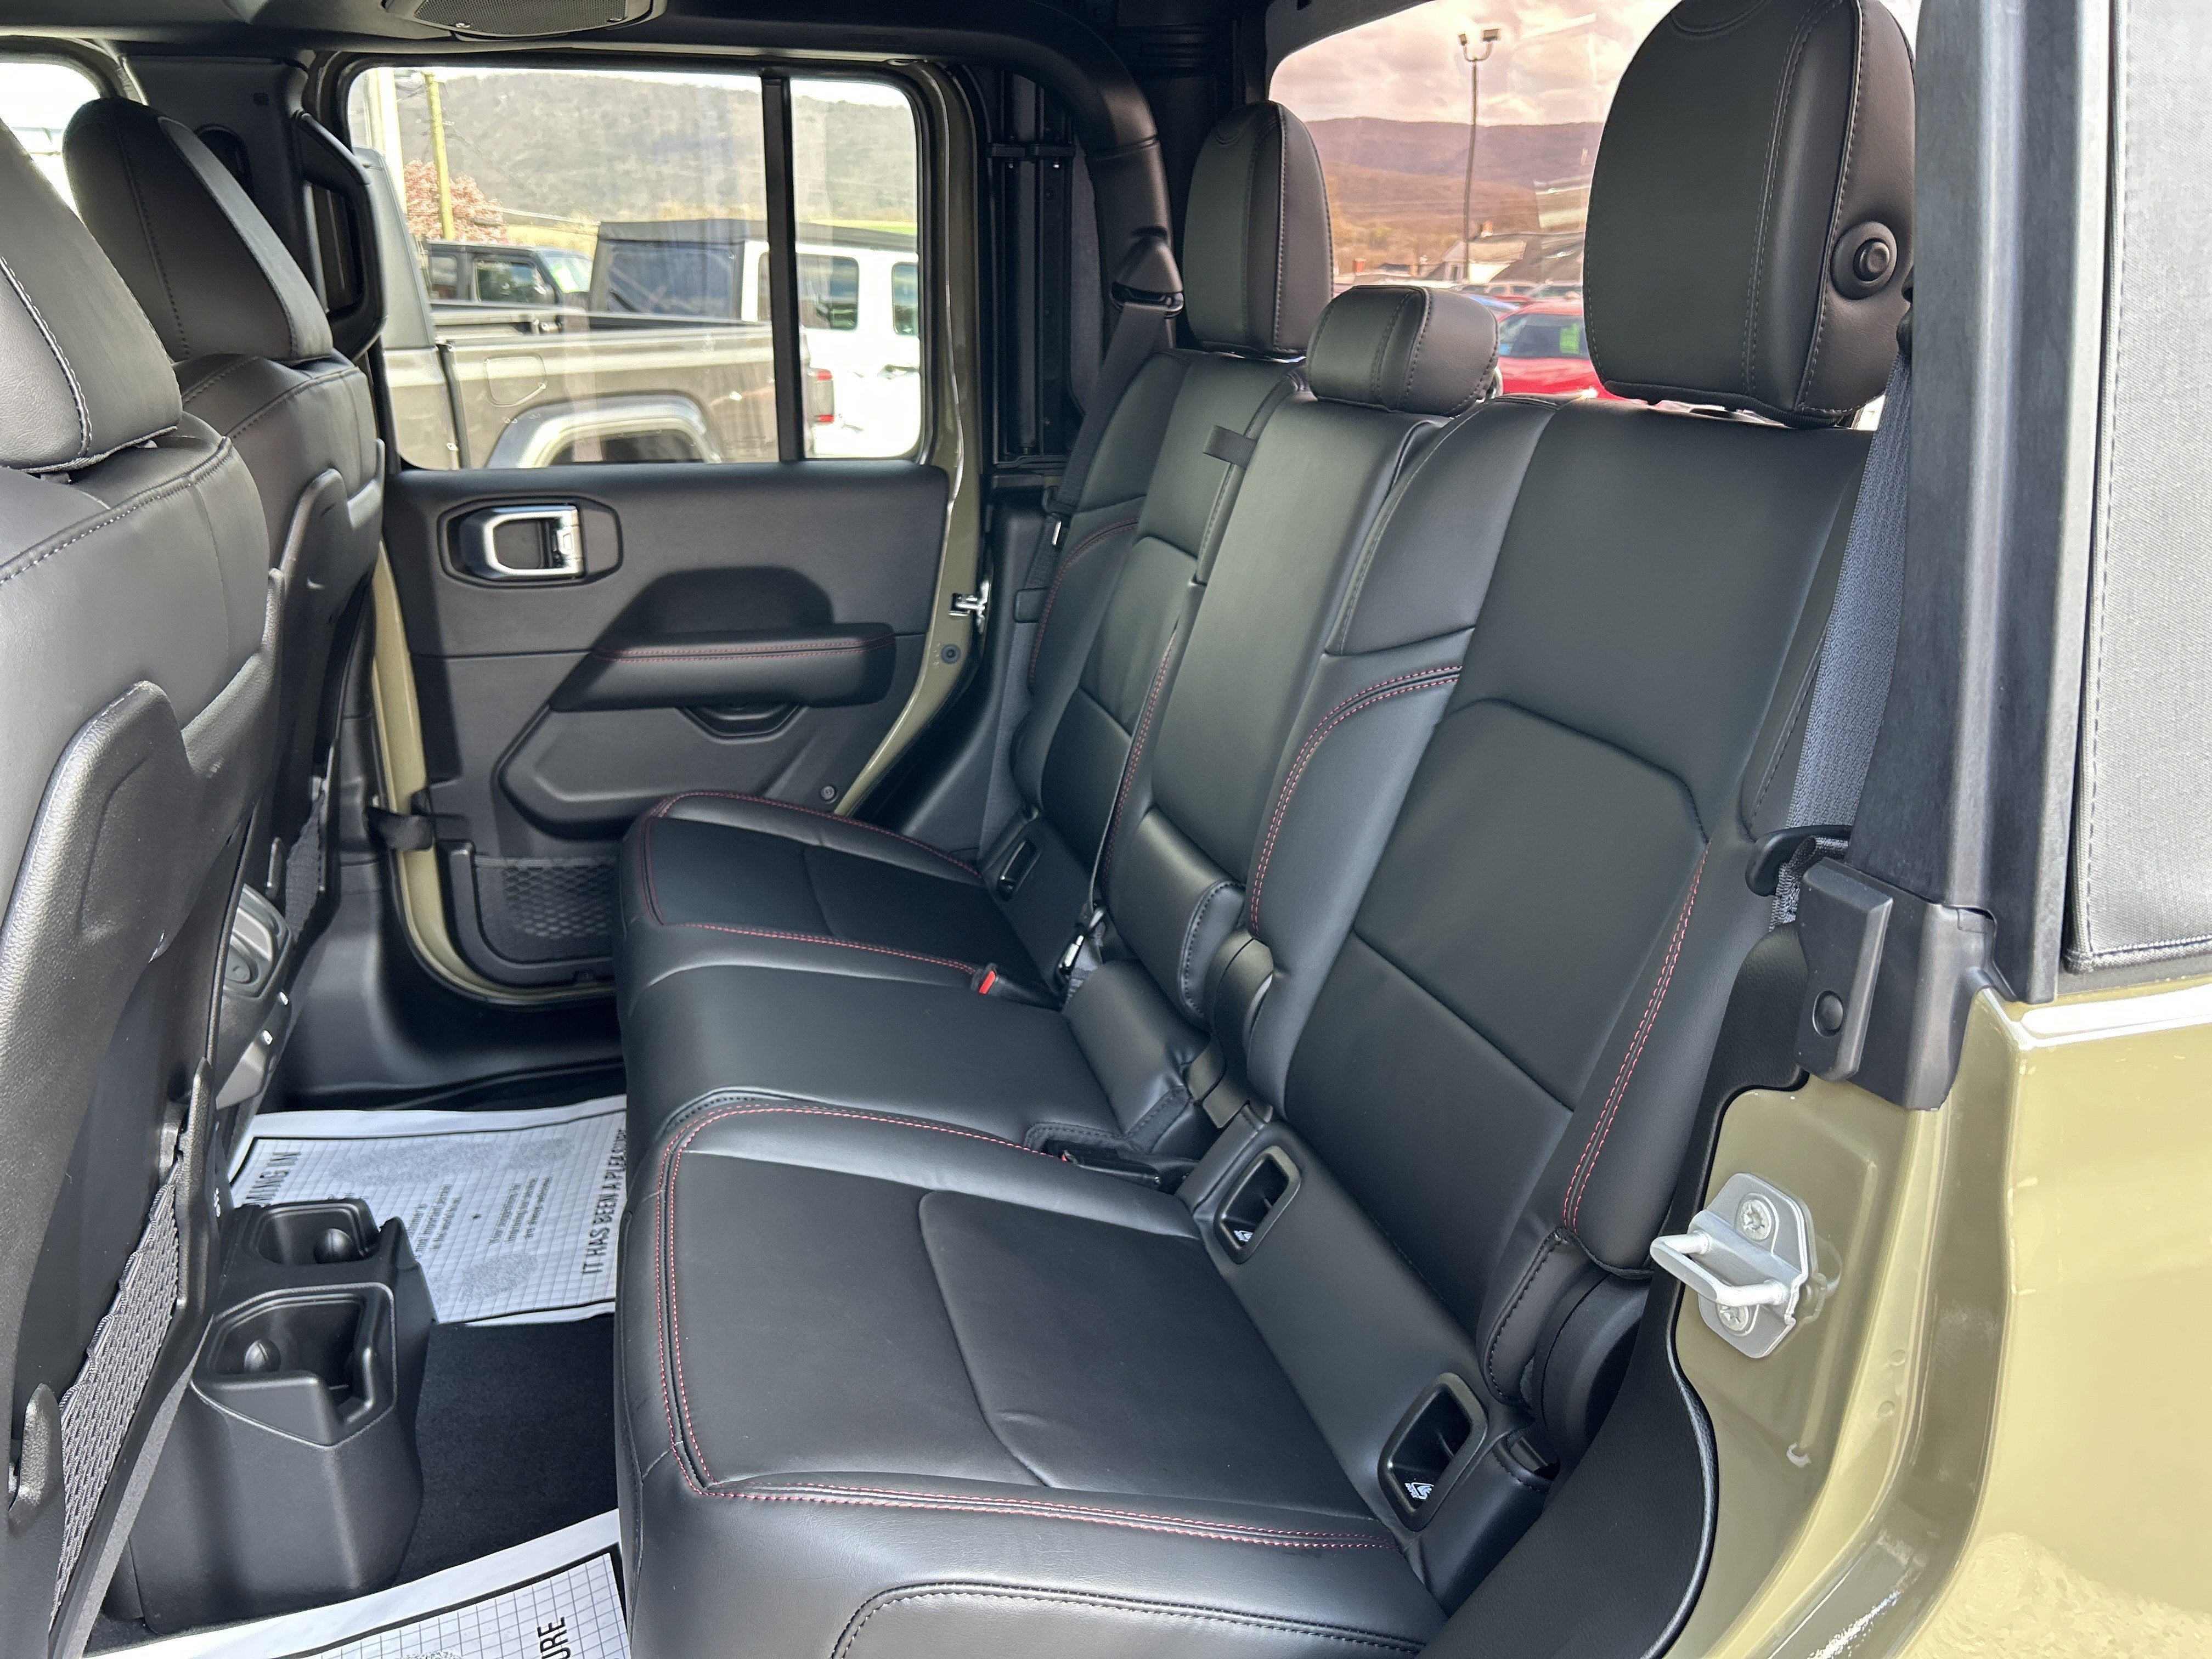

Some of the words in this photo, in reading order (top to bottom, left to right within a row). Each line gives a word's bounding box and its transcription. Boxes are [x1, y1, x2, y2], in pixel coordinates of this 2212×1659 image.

[266, 1152, 301, 1167] IN
[602, 1182, 622, 1191] A
[592, 1193, 619, 1225] BEEN
[585, 1227, 611, 1256] HAS
[582, 1262, 604, 1274] IT
